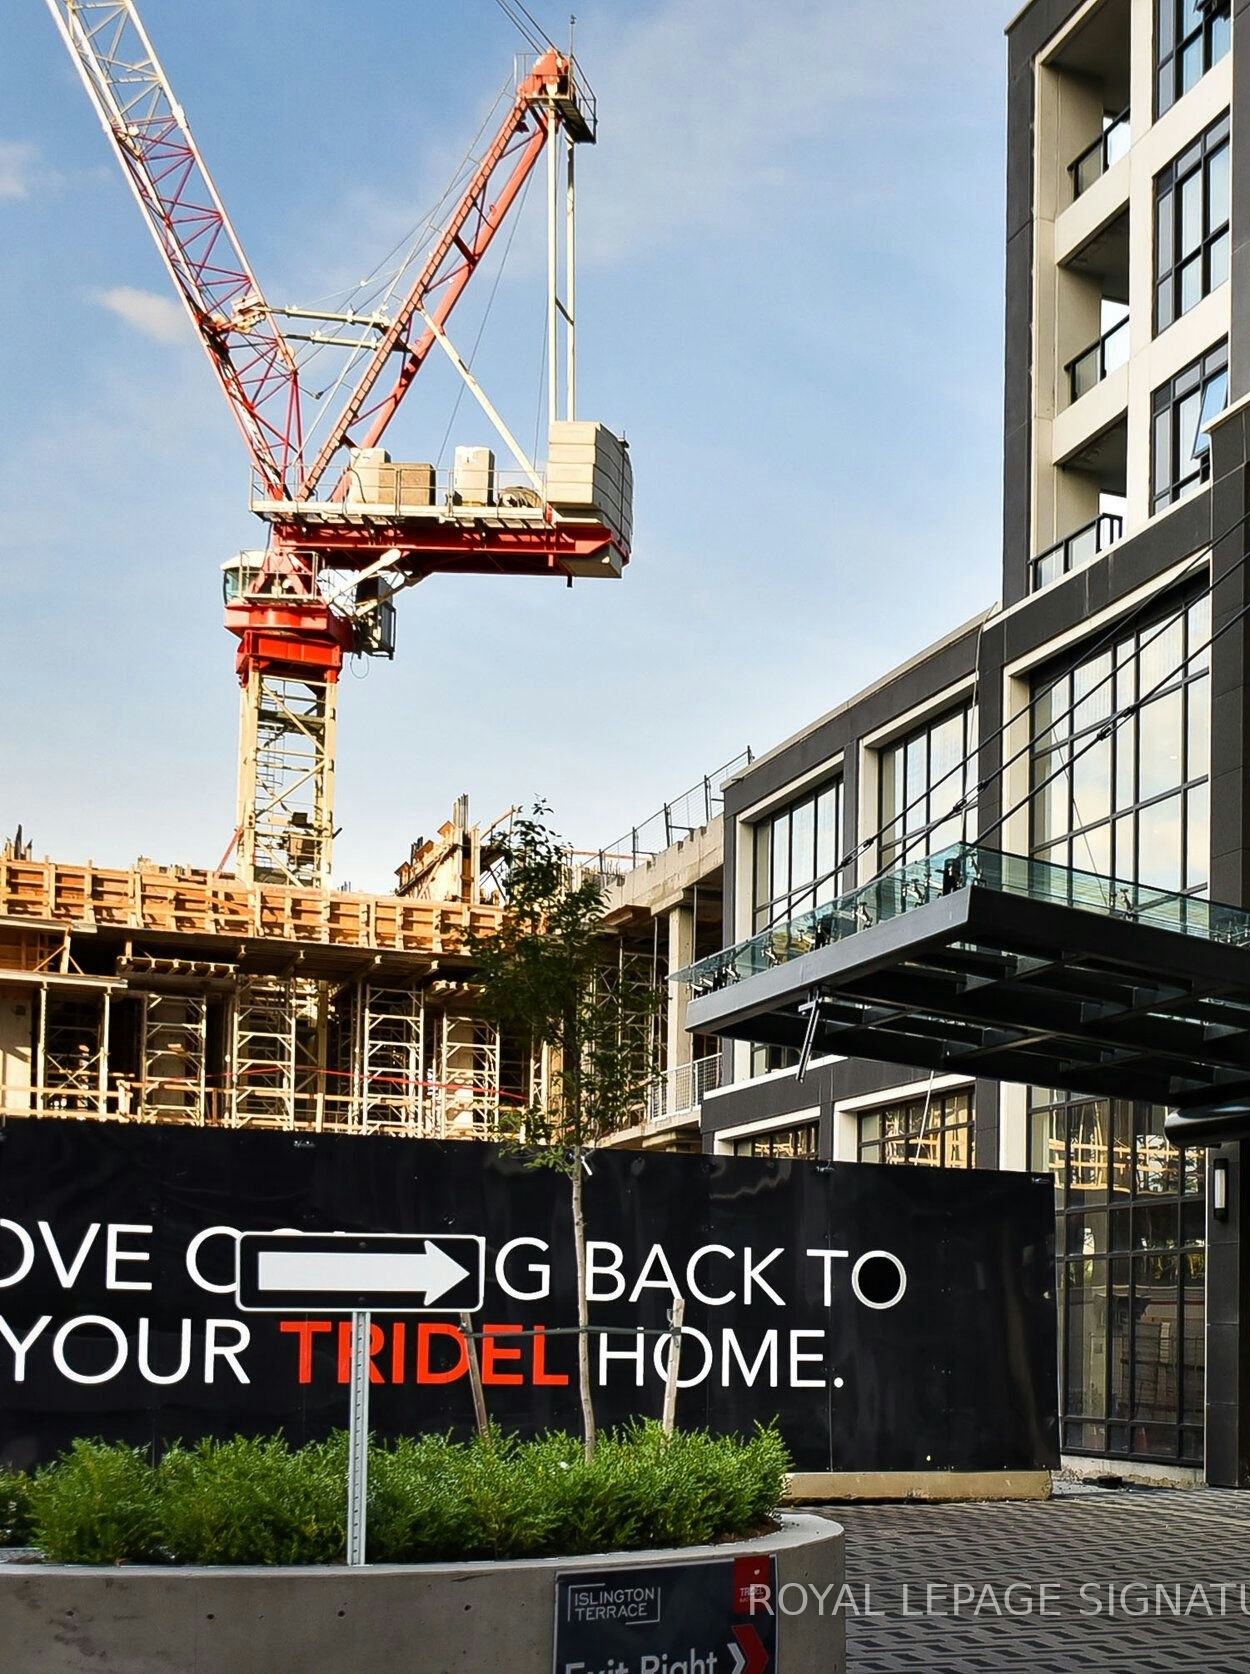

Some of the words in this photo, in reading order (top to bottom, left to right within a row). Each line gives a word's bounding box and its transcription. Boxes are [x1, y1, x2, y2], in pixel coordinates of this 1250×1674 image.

[585, 1241, 785, 1306] BACK
[806, 1248, 907, 1310] TO
[0, 1314, 251, 1385] YOUR
[280, 1320, 569, 1386] TRIDEL
[599, 1326, 844, 1388] HOME.
[575, 1587, 654, 1606] ISLINGTON
[575, 1603, 647, 1621] TERRACE
